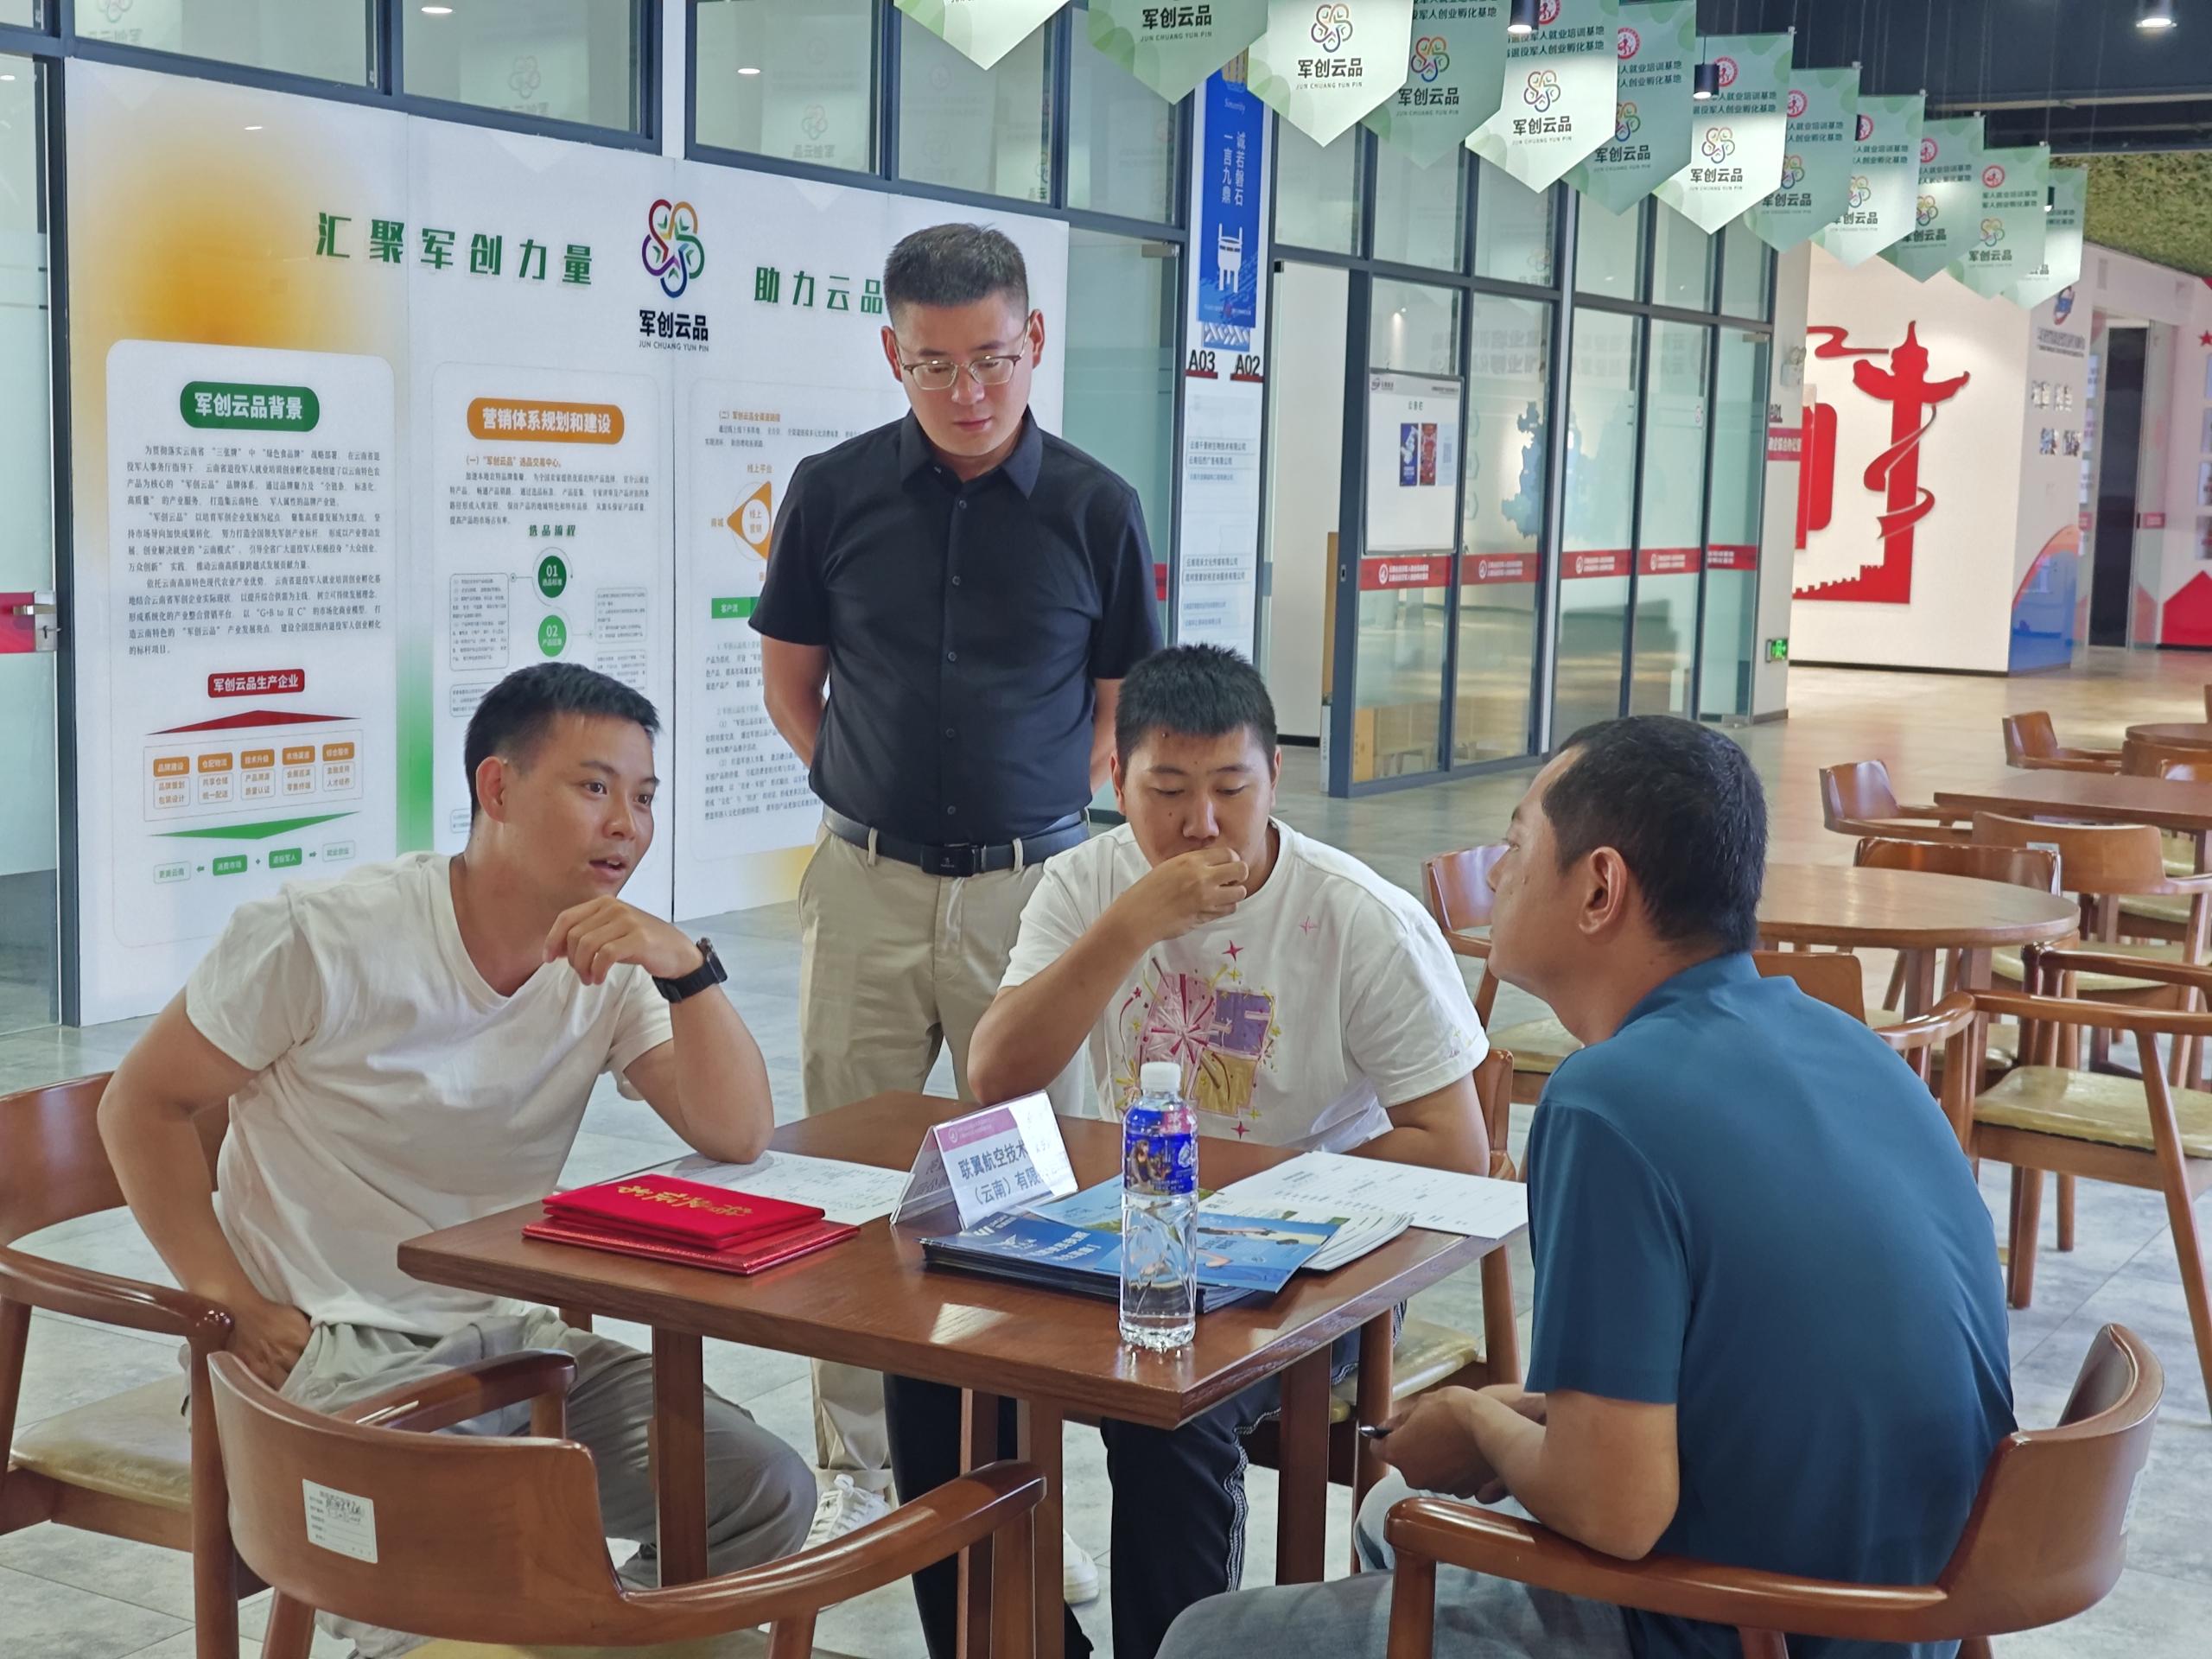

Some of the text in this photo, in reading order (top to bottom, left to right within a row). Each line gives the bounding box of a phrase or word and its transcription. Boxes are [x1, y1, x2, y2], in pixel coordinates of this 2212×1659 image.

[1141, 4, 1212, 30] 军创云品
[1297, 57, 1363, 79] 军创云品
[1618, 60, 1682, 74] 人就业培训基地
[1618, 74, 1682, 88] 人创业孵化基地
[1397, 87, 1459, 106] 军创云品
[1513, 115, 1573, 136] 军创云品
[1595, 144, 1651, 163] 军创云品
[1690, 168, 1744, 183] 军创云品
[315, 213, 593, 285] 汇聚军创力量
[753, 266, 883, 315] 助力云品
[639, 308, 709, 341] 军创云品
[653, 341, 681, 351] CHUANG
[683, 343, 697, 352] YUN
[1189, 349, 1216, 372] A03
[1236, 354, 1261, 376] A02
[195, 391, 303, 422] 军创云品背景
[482, 407, 612, 434] 营销体系规划和建设
[529, 524, 576, 537] 选品流程
[546, 564, 558, 577] 01
[546, 625, 558, 638] 02
[213, 674, 299, 693] 军创云品生产企业
[958, 1141, 1029, 1180] 联翼航空技术
